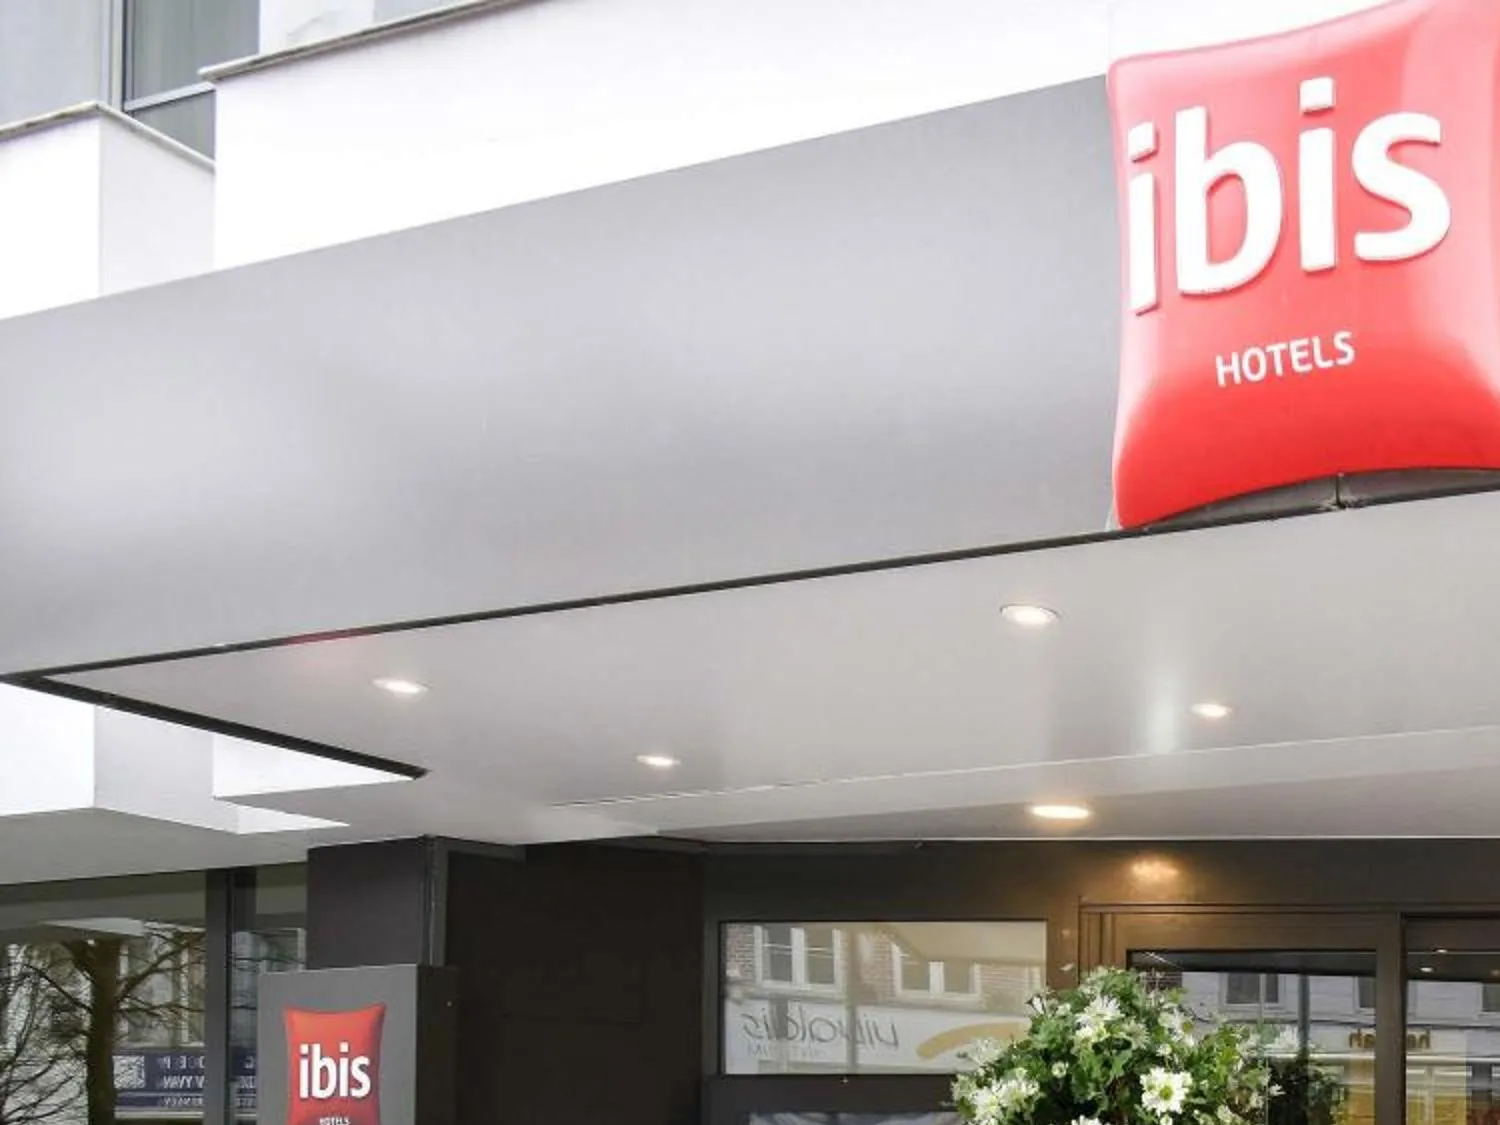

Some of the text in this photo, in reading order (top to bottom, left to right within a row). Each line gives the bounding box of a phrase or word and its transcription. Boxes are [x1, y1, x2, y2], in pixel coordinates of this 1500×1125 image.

[1126, 76, 1453, 316] ibis
[1215, 330, 1356, 388] HOTELS
[299, 1041, 372, 1099] ibis
